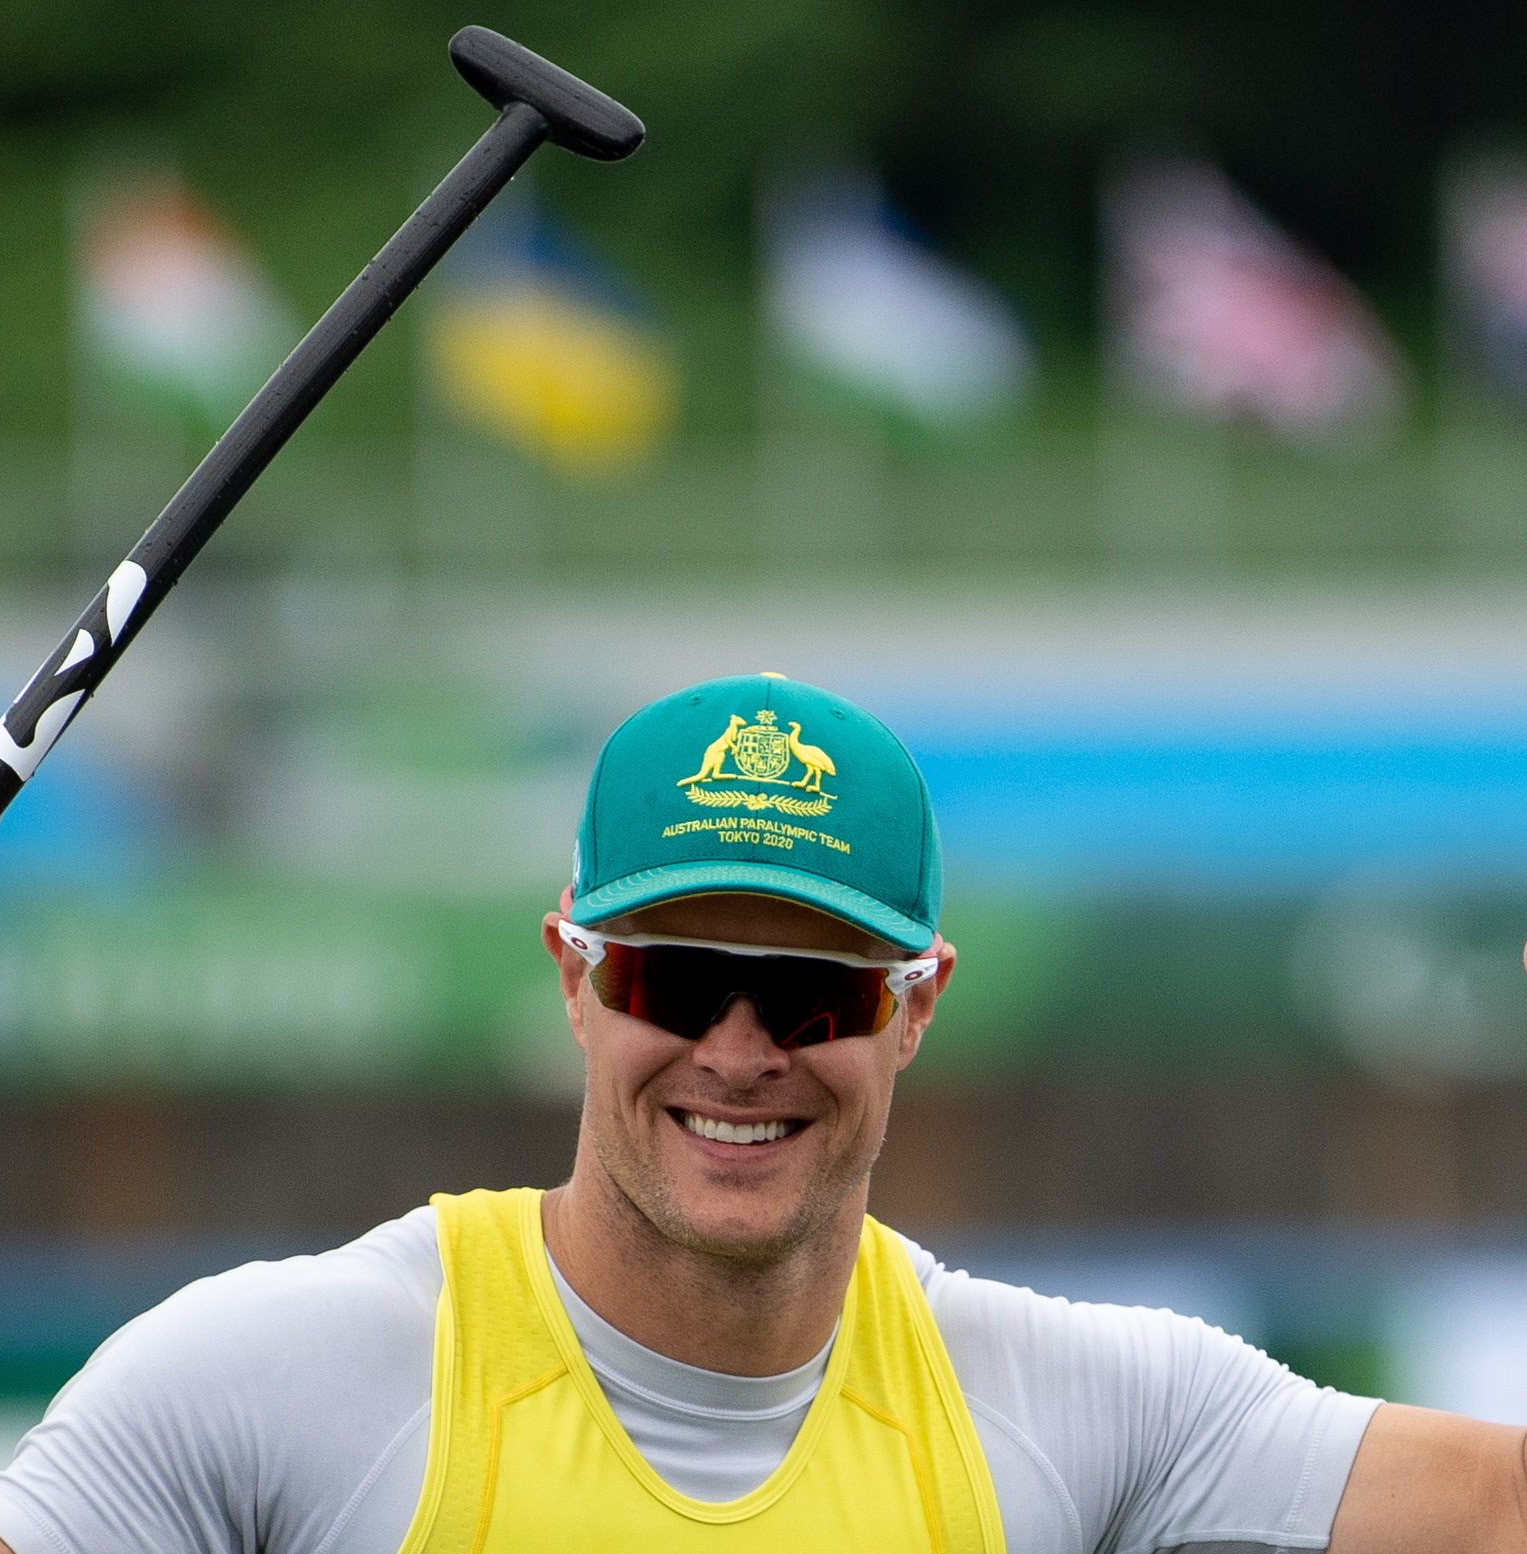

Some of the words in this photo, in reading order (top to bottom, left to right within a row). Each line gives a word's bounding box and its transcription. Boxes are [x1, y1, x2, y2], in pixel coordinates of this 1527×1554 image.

[662, 816, 738, 838] AUSTRALIAN
[740, 817, 818, 842] PARALYMPIC
[819, 832, 851, 855] TEAM
[718, 830, 760, 844] TOKYO
[763, 832, 794, 850] 2020
